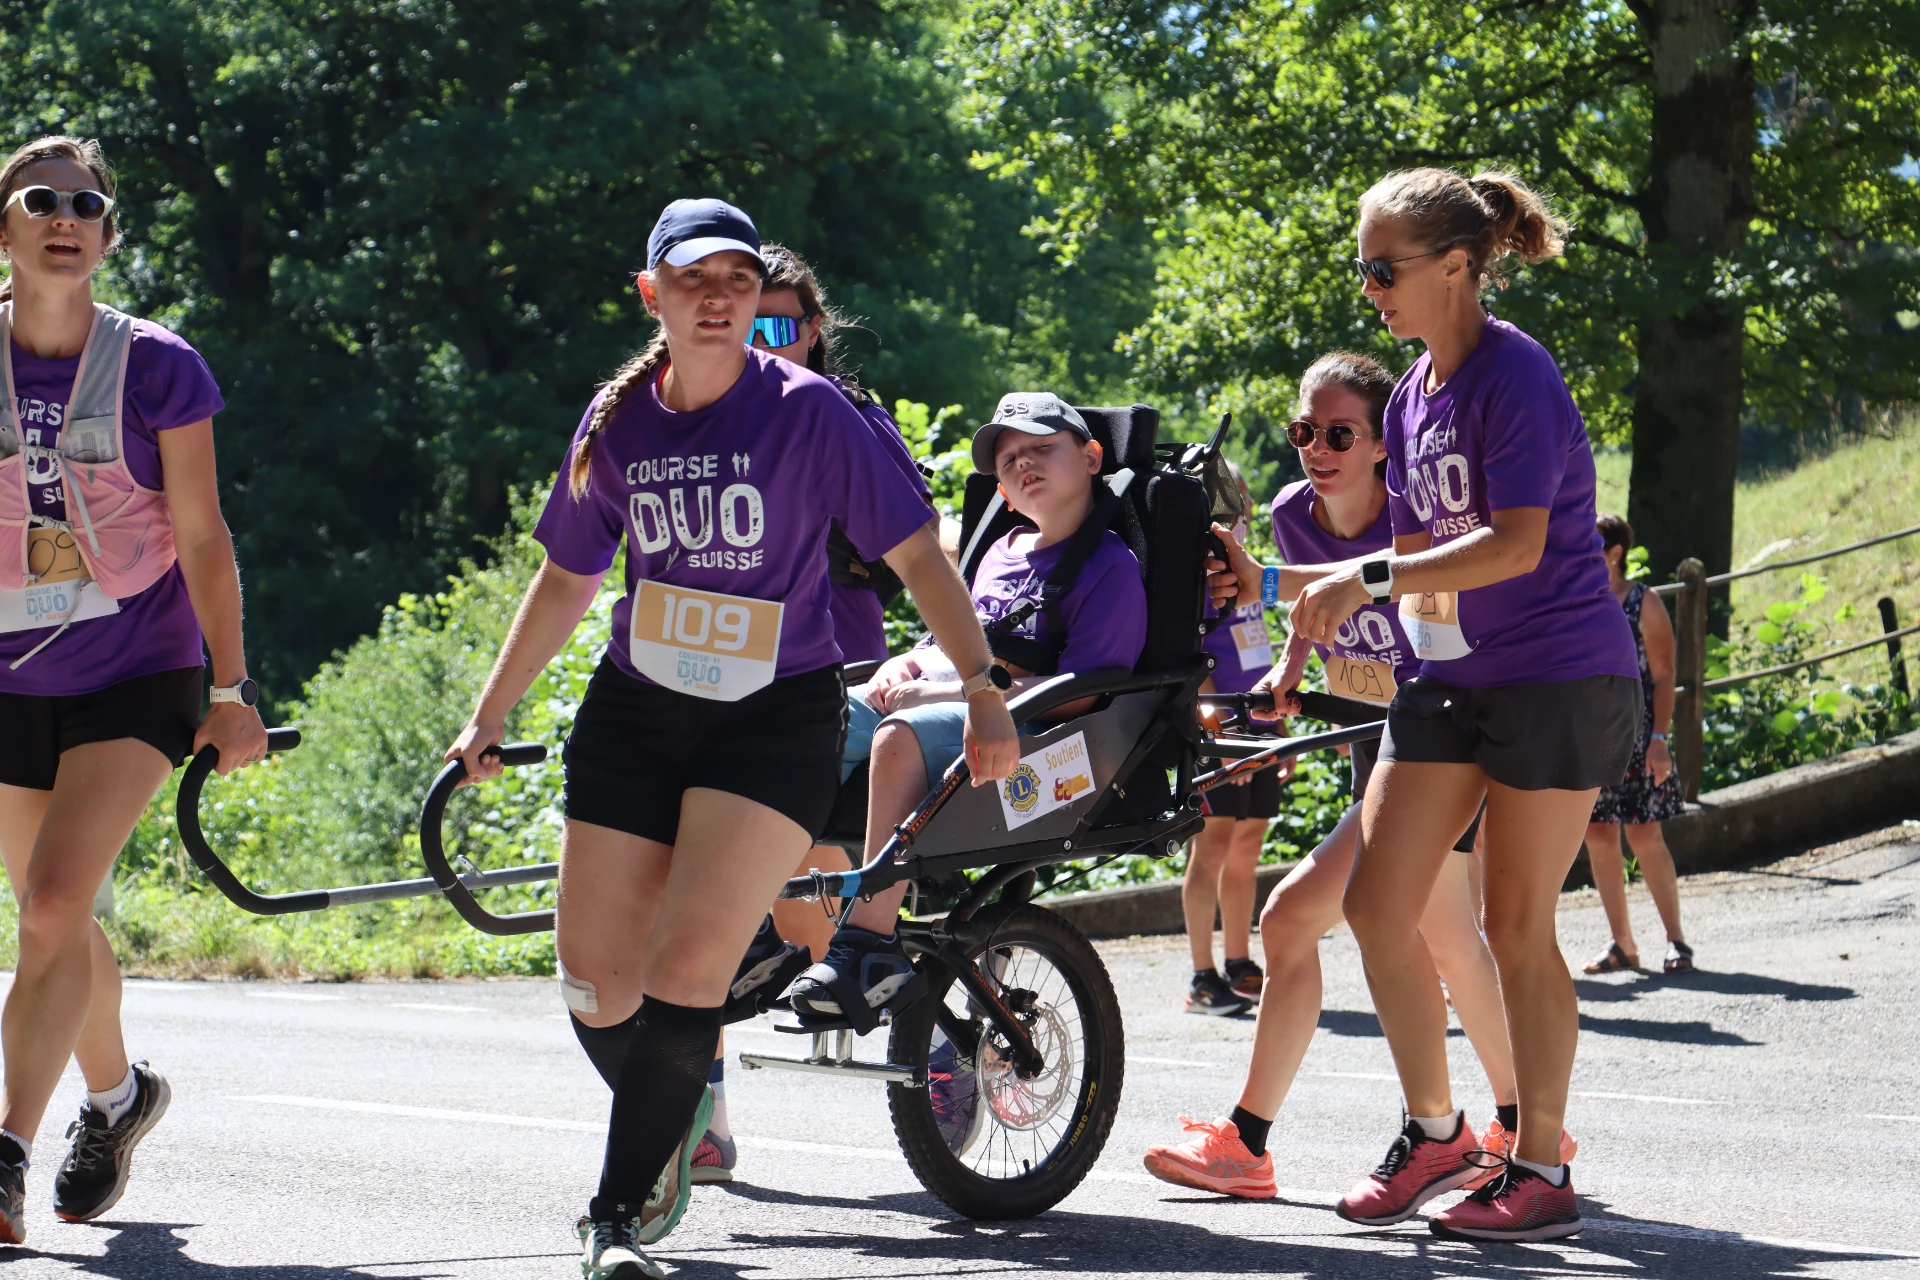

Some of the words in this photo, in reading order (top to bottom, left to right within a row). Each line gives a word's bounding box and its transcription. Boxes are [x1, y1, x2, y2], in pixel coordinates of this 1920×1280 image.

[626, 455, 718, 485] COURSE
[629, 483, 764, 554] DUO
[1432, 512, 1482, 537] UISSE
[28, 531, 81, 578] 09
[688, 549, 763, 570] SUISSE
[25, 586, 51, 597] COURSE
[1266, 572, 1274, 587] 120
[26, 593, 68, 616] DUO
[661, 593, 751, 651] 109
[1334, 610, 1396, 651] UO
[678, 651, 709, 663] COURSE
[677, 659, 721, 685] DUO
[1340, 660, 1384, 697] 109
[695, 682, 720, 692] SUISSE
[1045, 739, 1084, 771] Soutient
[1008, 766, 1030, 780] LIONS
[1016, 779, 1029, 796] L
[1069, 1115, 1088, 1147] JUMBO
